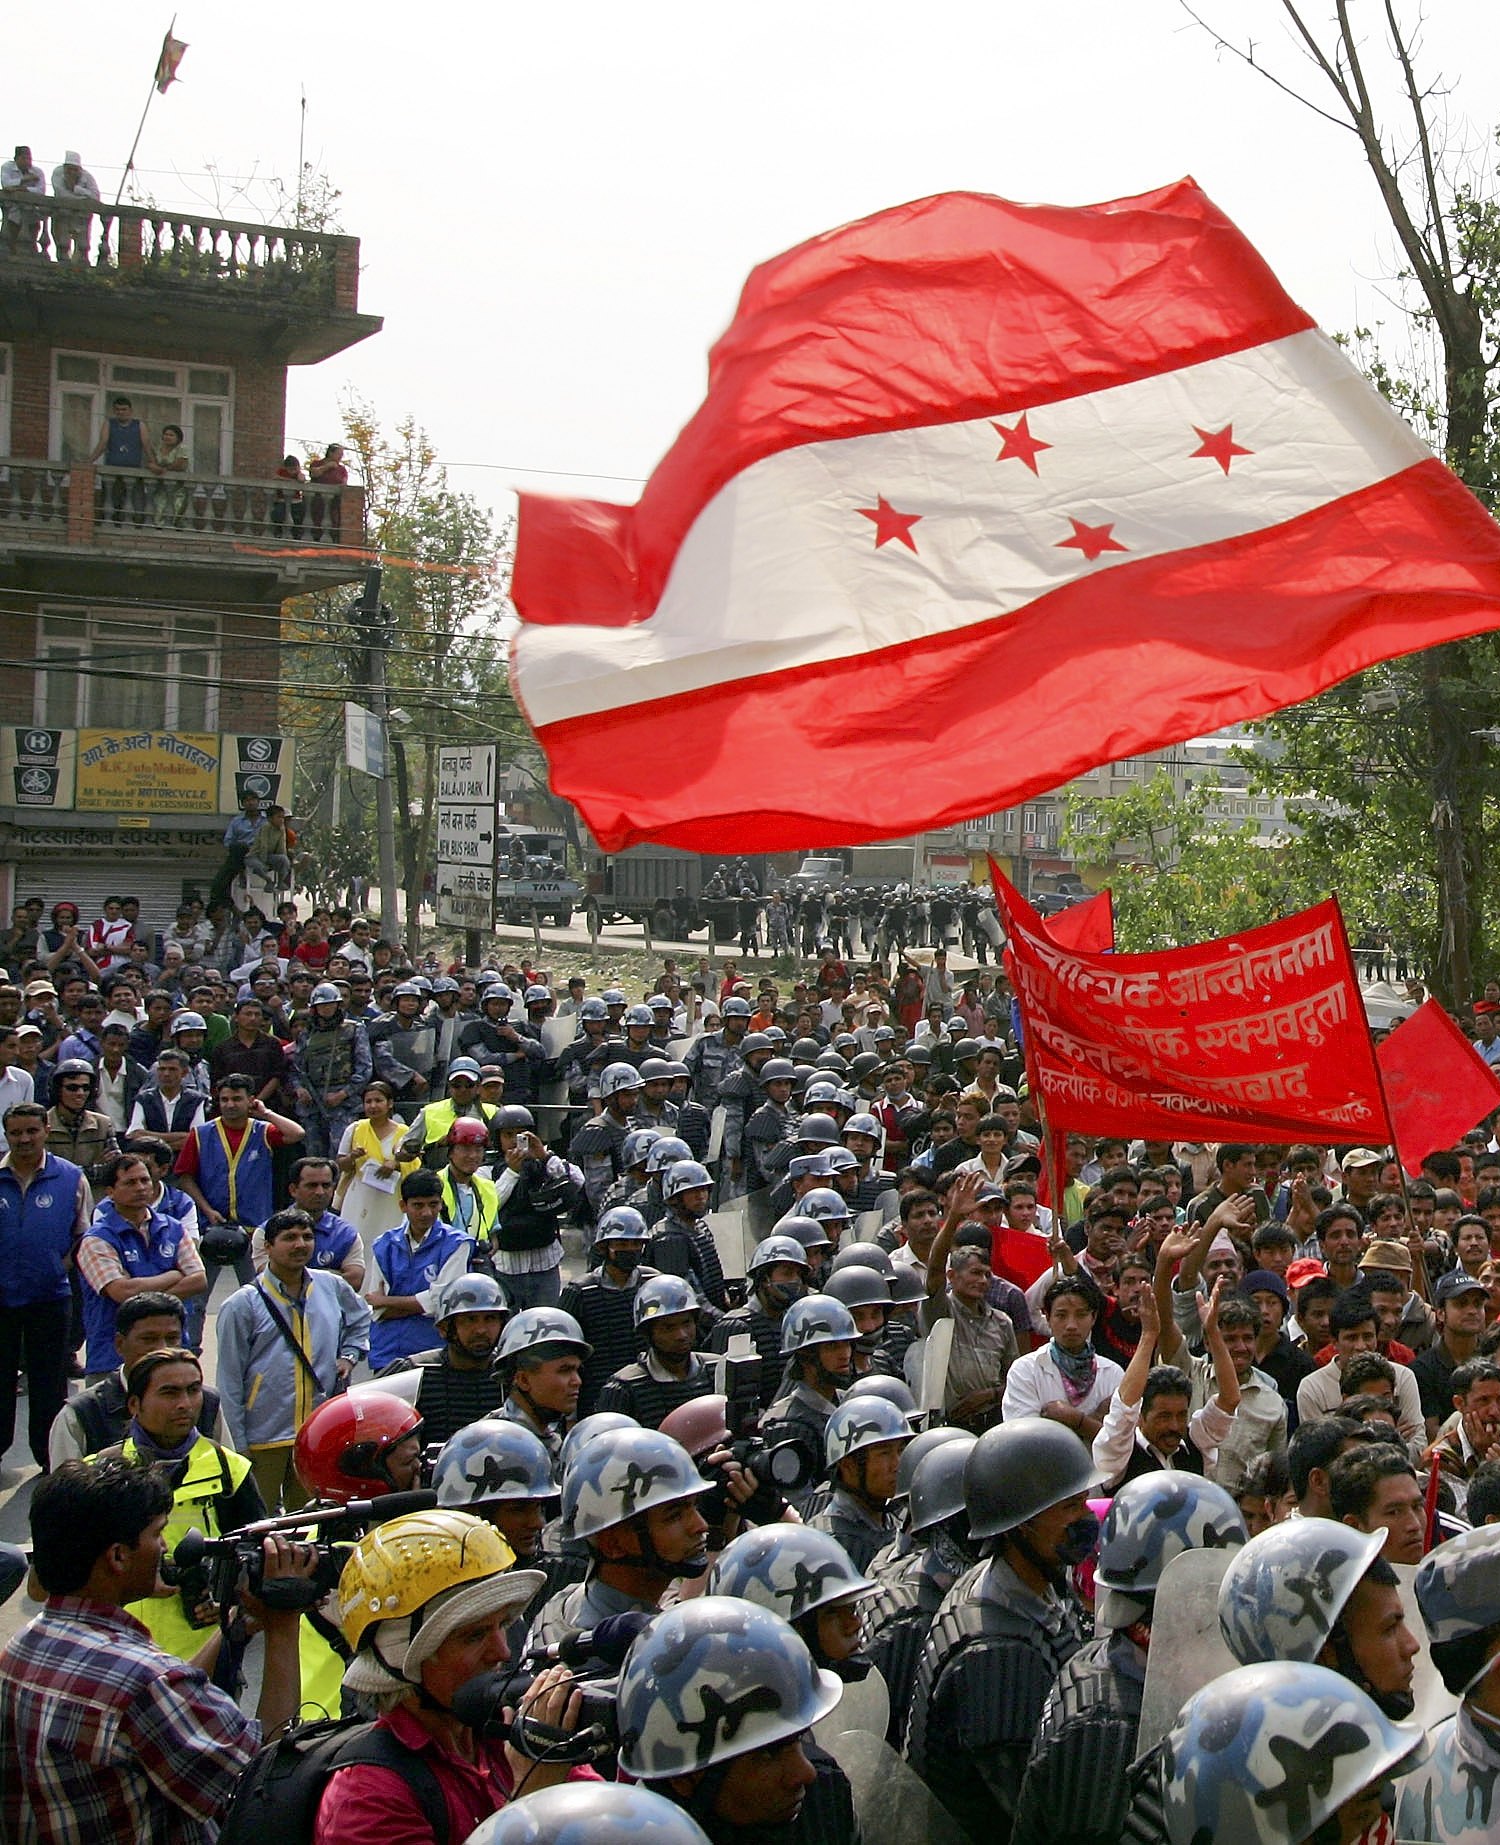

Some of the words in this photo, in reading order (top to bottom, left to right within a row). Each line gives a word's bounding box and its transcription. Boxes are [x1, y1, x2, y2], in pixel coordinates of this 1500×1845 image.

[467, 781, 483, 797] PARK
[451, 840, 463, 857] BUS
[463, 841, 479, 858] PARK
[532, 883, 560, 892] TATA
